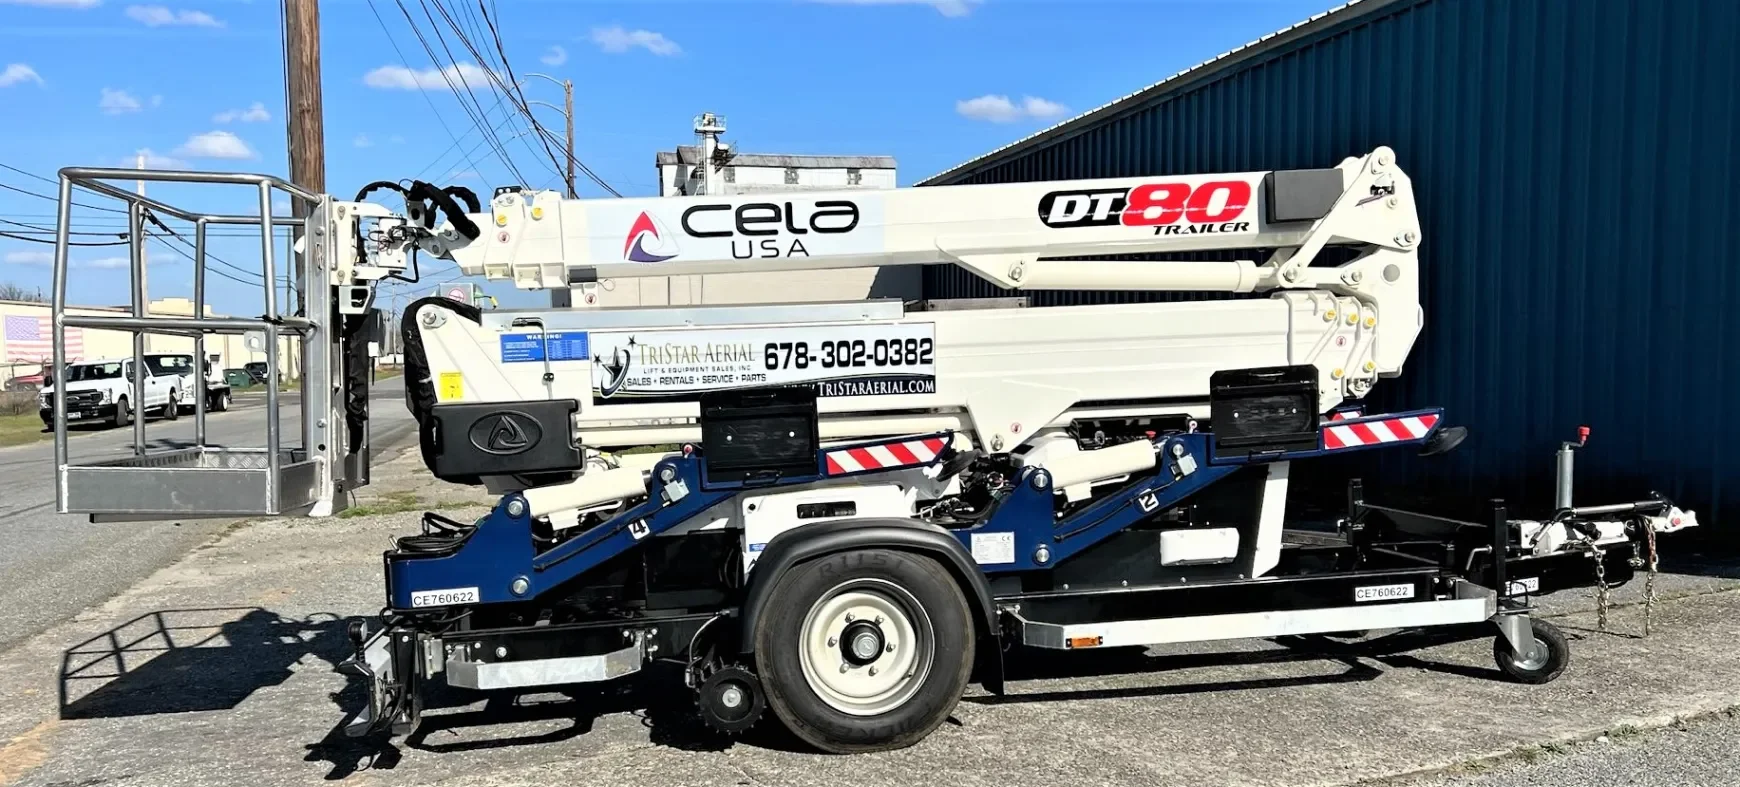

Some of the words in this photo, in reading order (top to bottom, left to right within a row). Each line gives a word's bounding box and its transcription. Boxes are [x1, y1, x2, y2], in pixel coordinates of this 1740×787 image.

[1046, 181, 1251, 226] DT80
[1153, 222, 1250, 236] TRAILER
[731, 238, 810, 259] USA
[626, 377, 651, 387] SALES
[660, 376, 694, 385] RENTALS
[702, 374, 733, 384] SERVICE
[741, 373, 766, 382] PARTS
[1141, 491, 1157, 508] 2
[633, 519, 646, 535] 4
[413, 591, 474, 606] CE760622
[1356, 586, 1408, 599] CE760622
